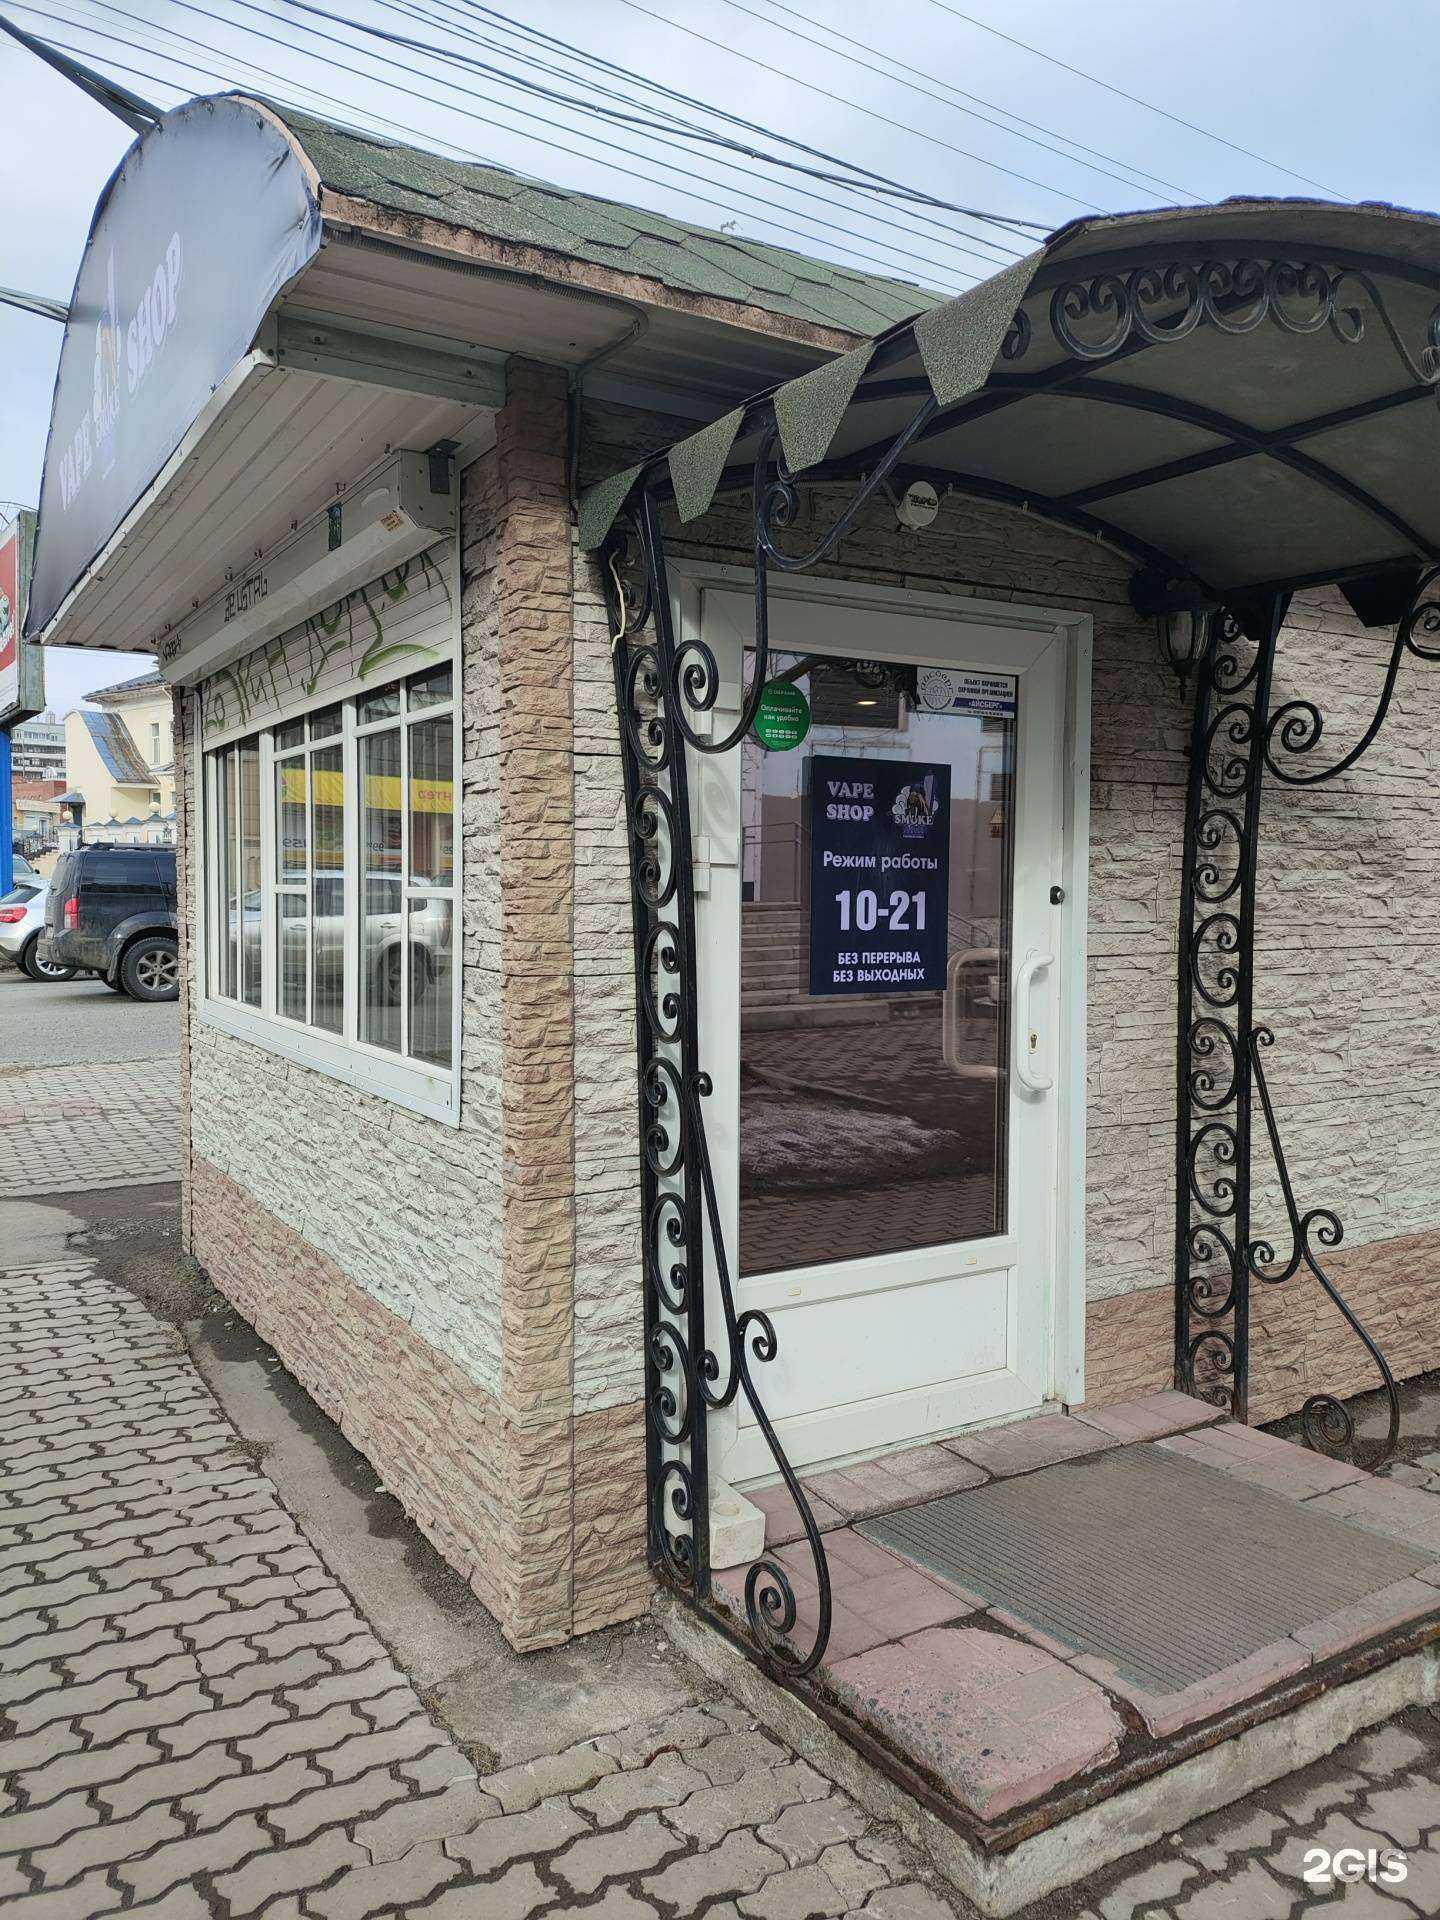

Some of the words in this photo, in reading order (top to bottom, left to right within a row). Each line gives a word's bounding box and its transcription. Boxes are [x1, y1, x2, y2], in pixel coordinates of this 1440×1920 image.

[127, 231, 182, 396] SHOP
[776, 714, 800, 722] удобно
[826, 781, 875, 799] VAPE
[826, 803, 875, 822] SHOP
[894, 814, 934, 826] SMOKE
[823, 850, 876, 868] Режим
[881, 853, 938, 873] работы
[835, 889, 926, 931] 10-21
[838, 952, 859, 965] БЕЗ
[862, 951, 921, 964] ПЕРЕРЫВА
[833, 970, 854, 983] БЕЗ
[857, 967, 925, 982] ВЫХОДНЫХ
